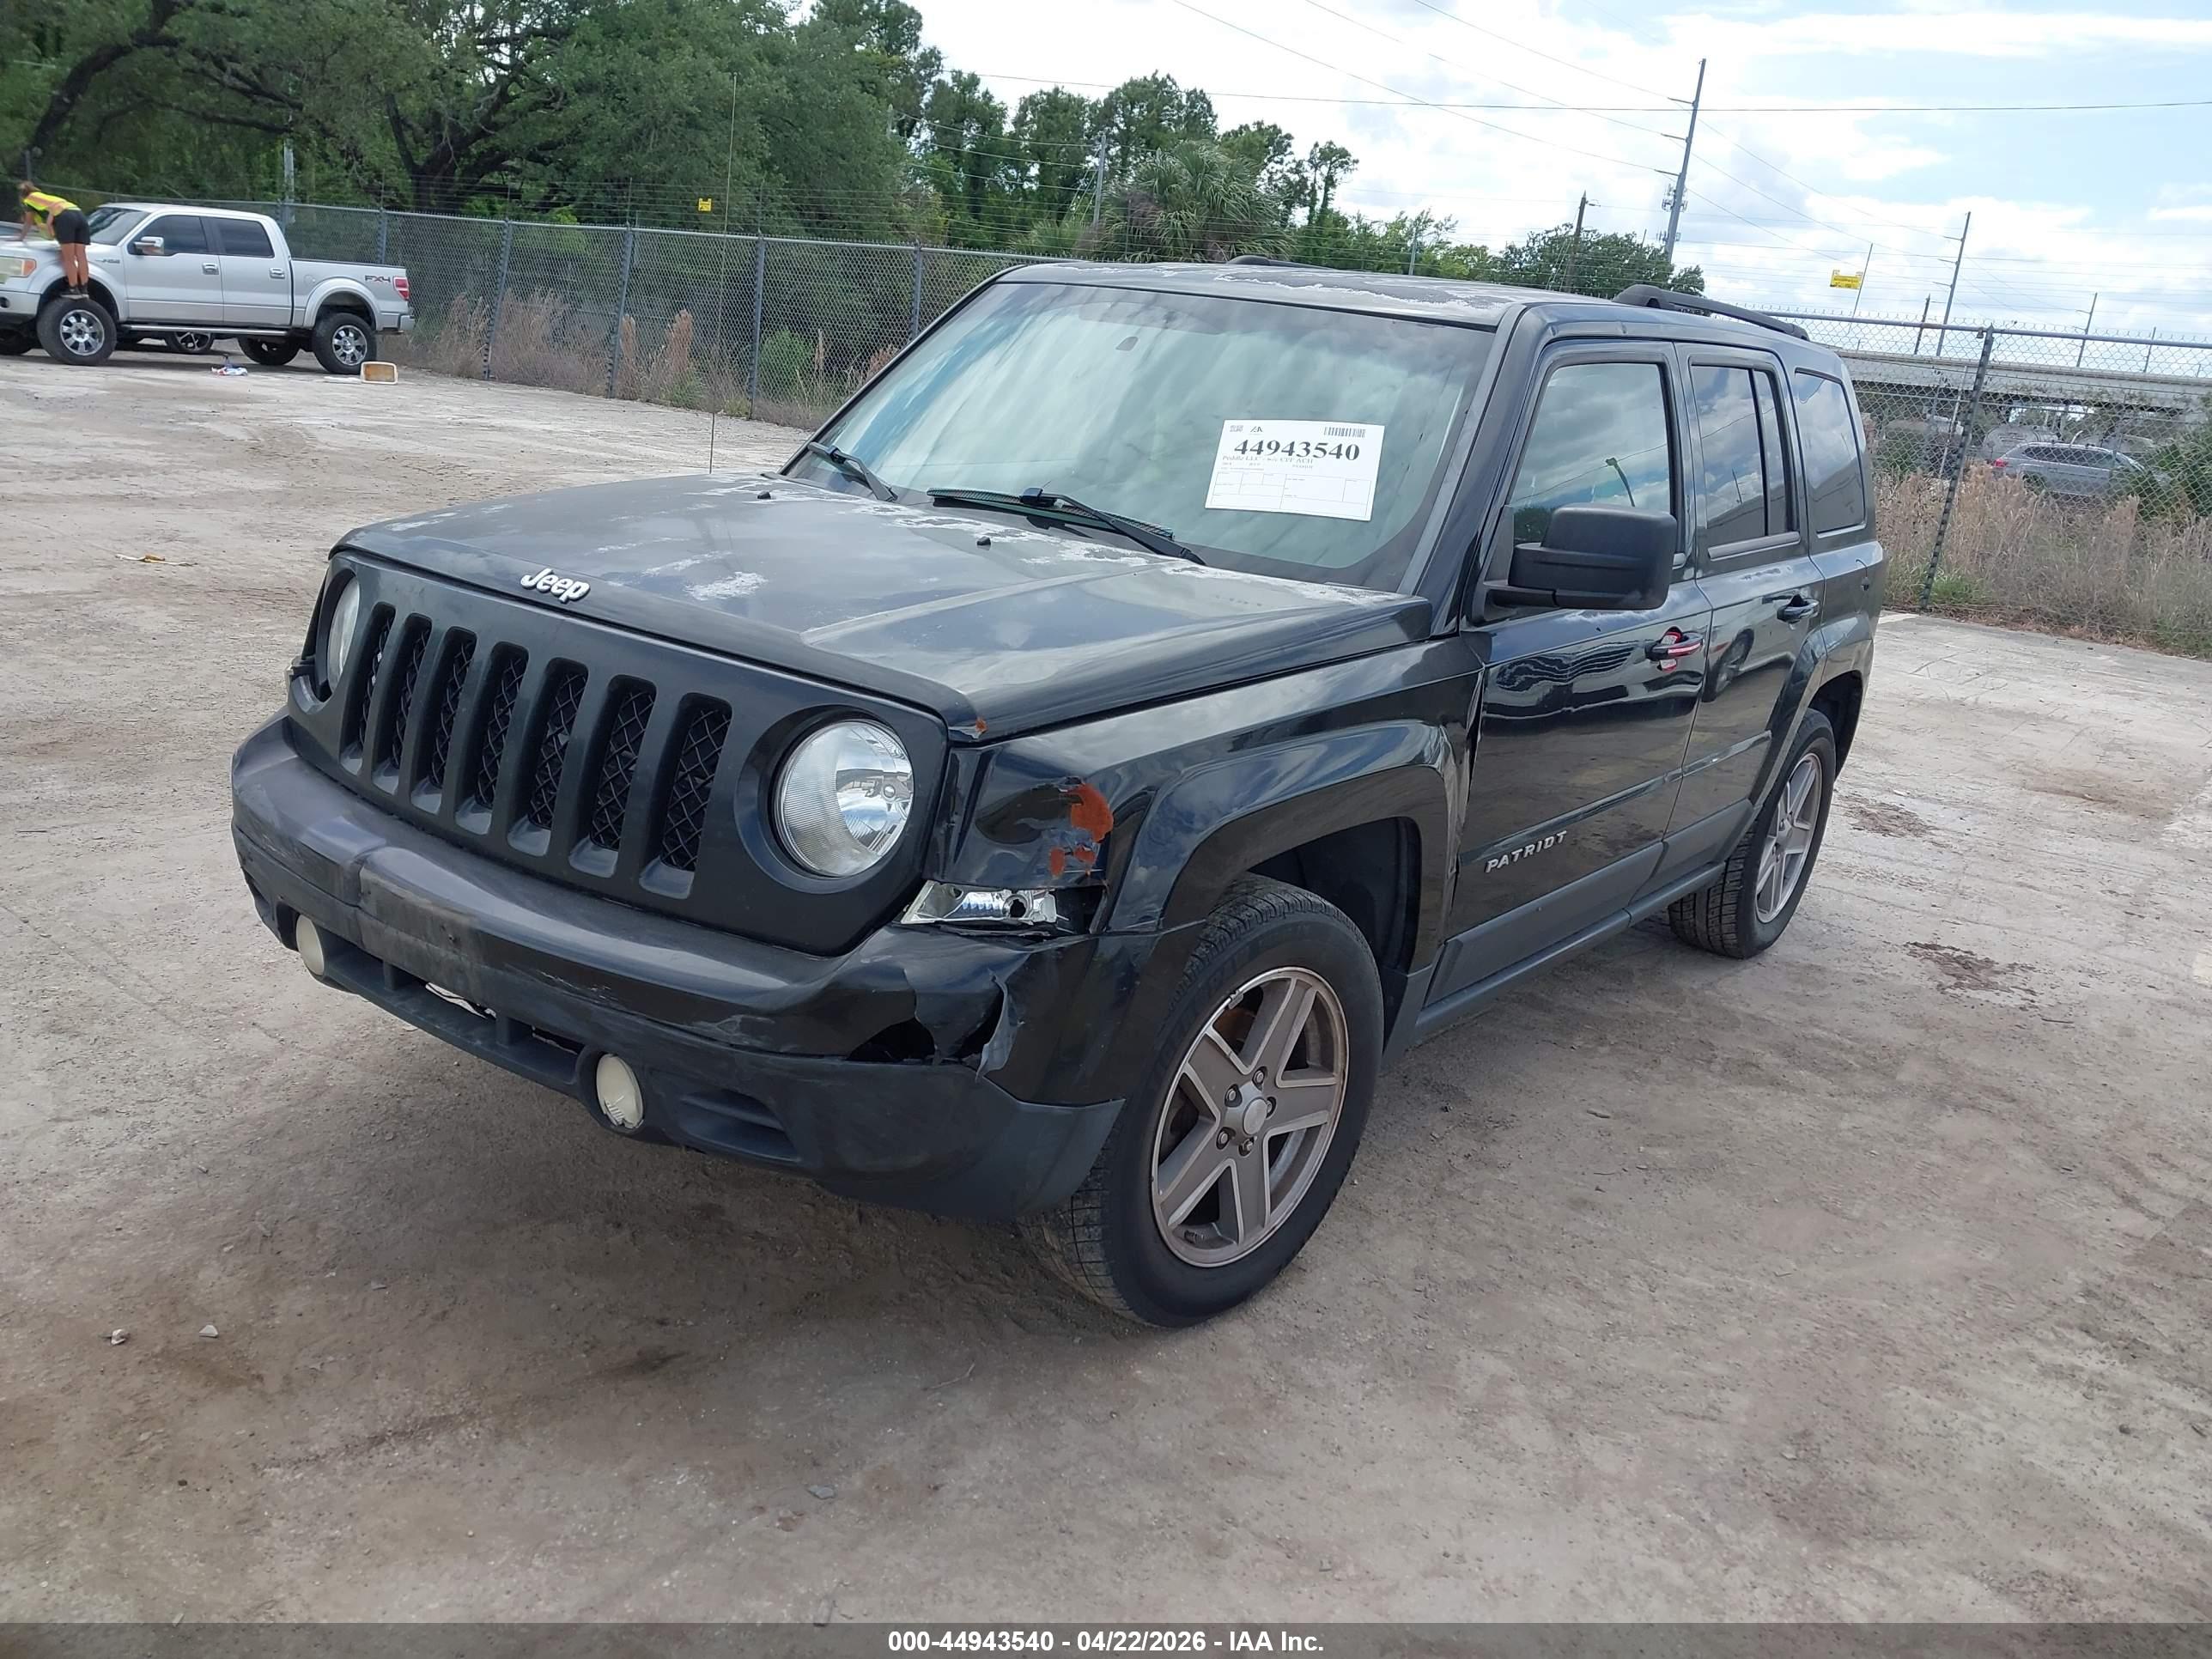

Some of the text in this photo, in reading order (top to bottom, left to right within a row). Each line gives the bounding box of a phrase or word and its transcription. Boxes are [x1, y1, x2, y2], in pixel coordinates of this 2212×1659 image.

[1234, 439, 1360, 461] 44943540
[520, 568, 591, 605] Jeep
[1485, 830, 1567, 873] PATRIOT
